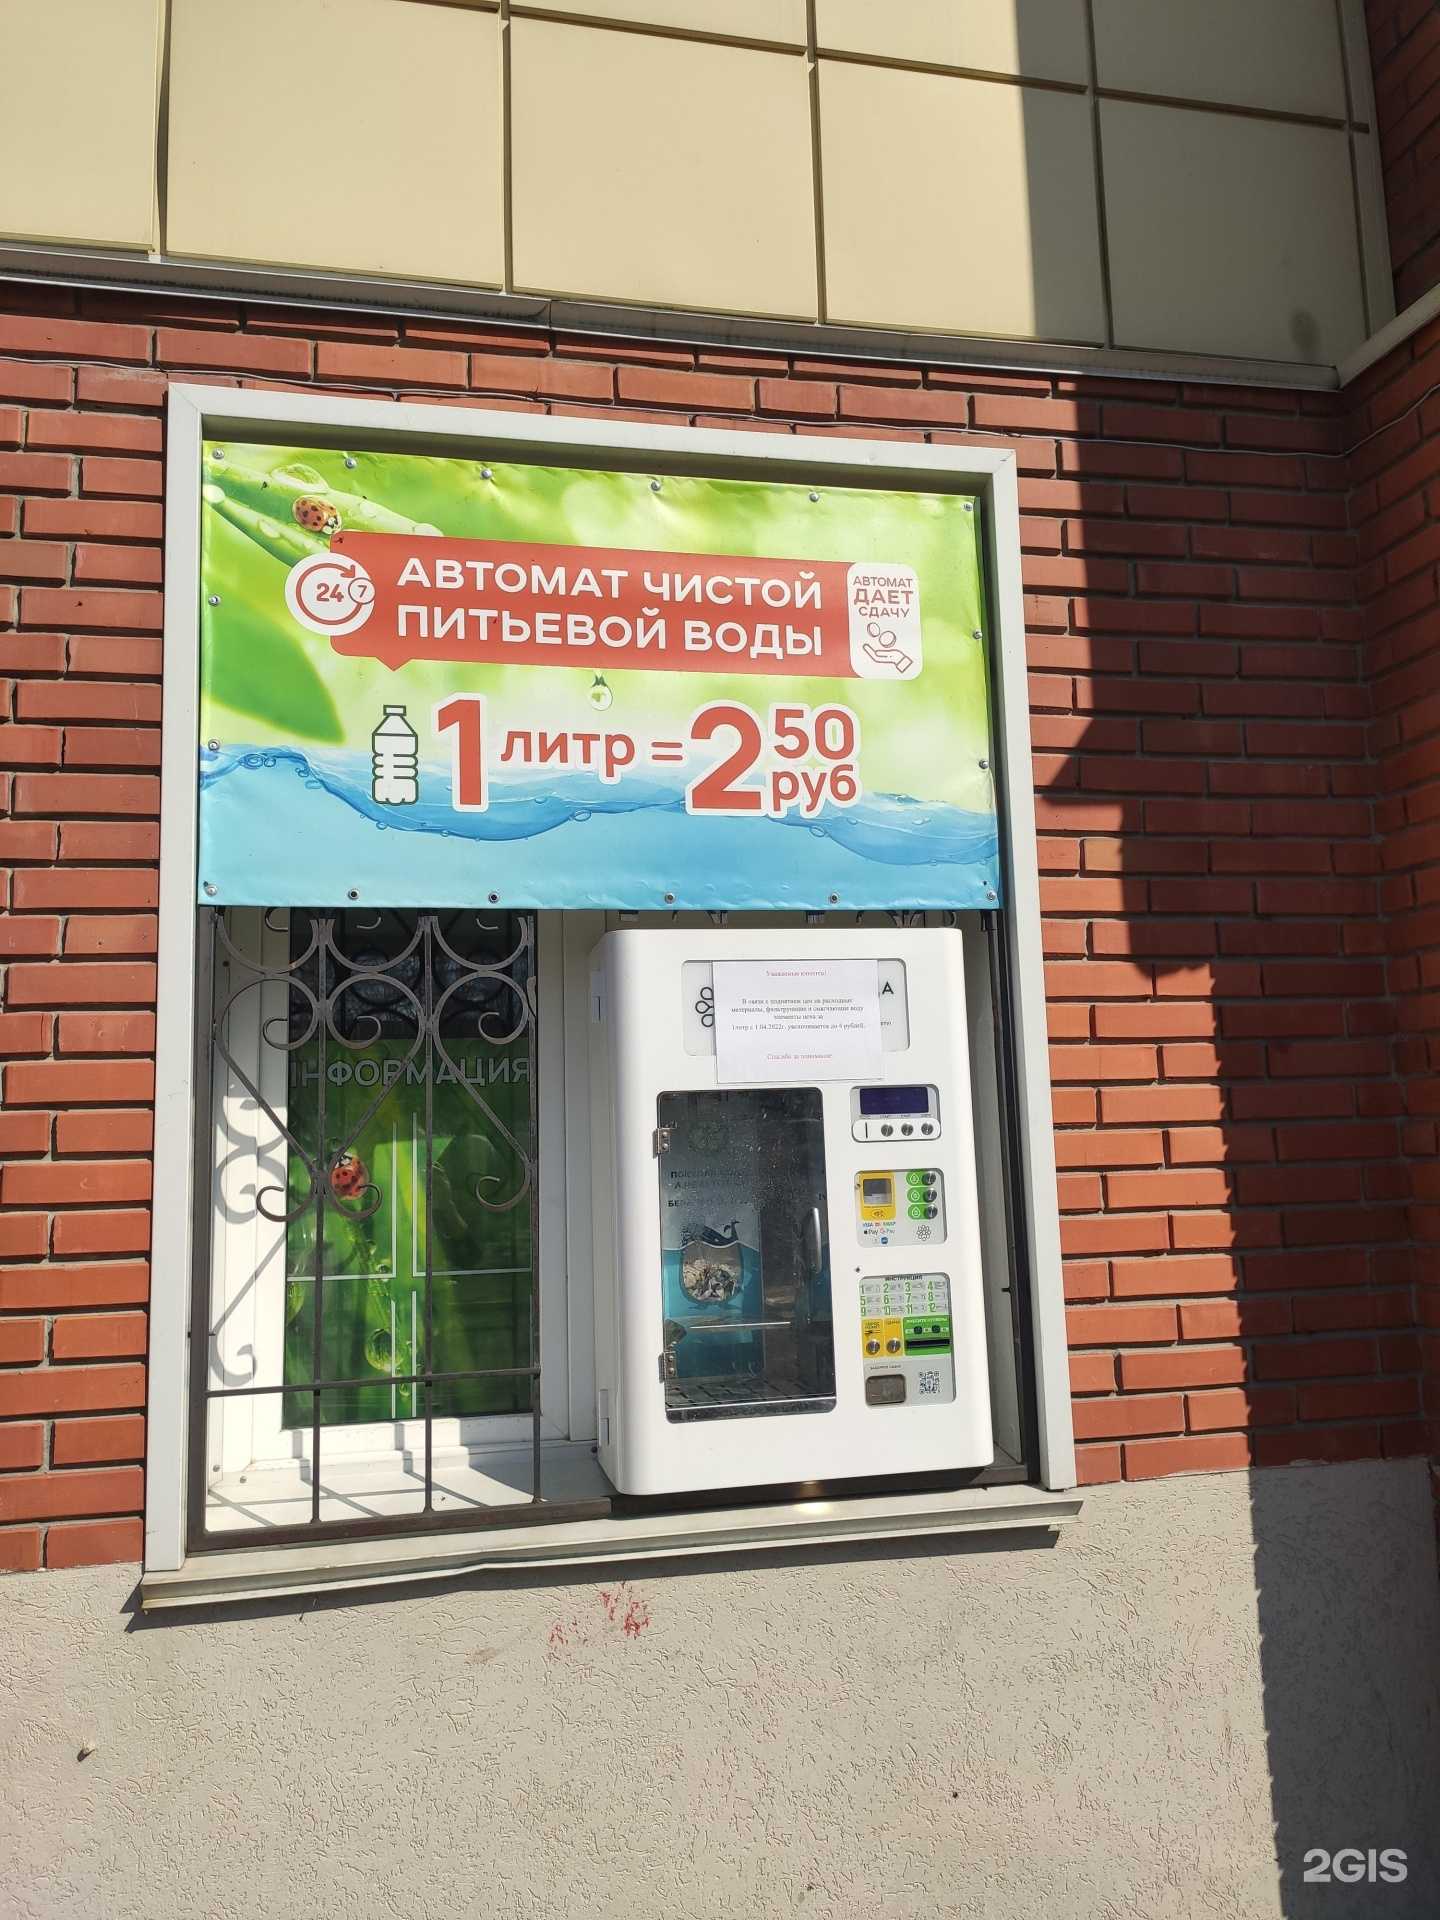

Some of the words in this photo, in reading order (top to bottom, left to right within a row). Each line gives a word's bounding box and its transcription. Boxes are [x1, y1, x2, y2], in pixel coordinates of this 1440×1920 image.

[397, 557, 629, 599] АВТОМАТ
[644, 571, 822, 609] ЧИСТОЙ
[853, 575, 913, 589] АВТОМАТ
[316, 582, 344, 603] 24
[357, 584, 367, 597] 7
[853, 588, 914, 606] ДАЕТ
[858, 605, 910, 619] СДАЧУ
[397, 604, 667, 650] ПИТЬЕВОЙ
[684, 619, 822, 660] ВОДЫ
[437, 699, 482, 806] 1
[500, 730, 636, 778] литр
[690, 705, 762, 809] 2
[773, 708, 855, 760] 50
[772, 764, 857, 812] руб
[883, 1283, 889, 1293] 2
[905, 1282, 911, 1292] 3
[927, 1281, 934, 1290] 4
[860, 1296, 866, 1305] 5
[884, 1294, 890, 1304] 6
[905, 1293, 912, 1303] 7
[861, 1306, 866, 1316] 9
